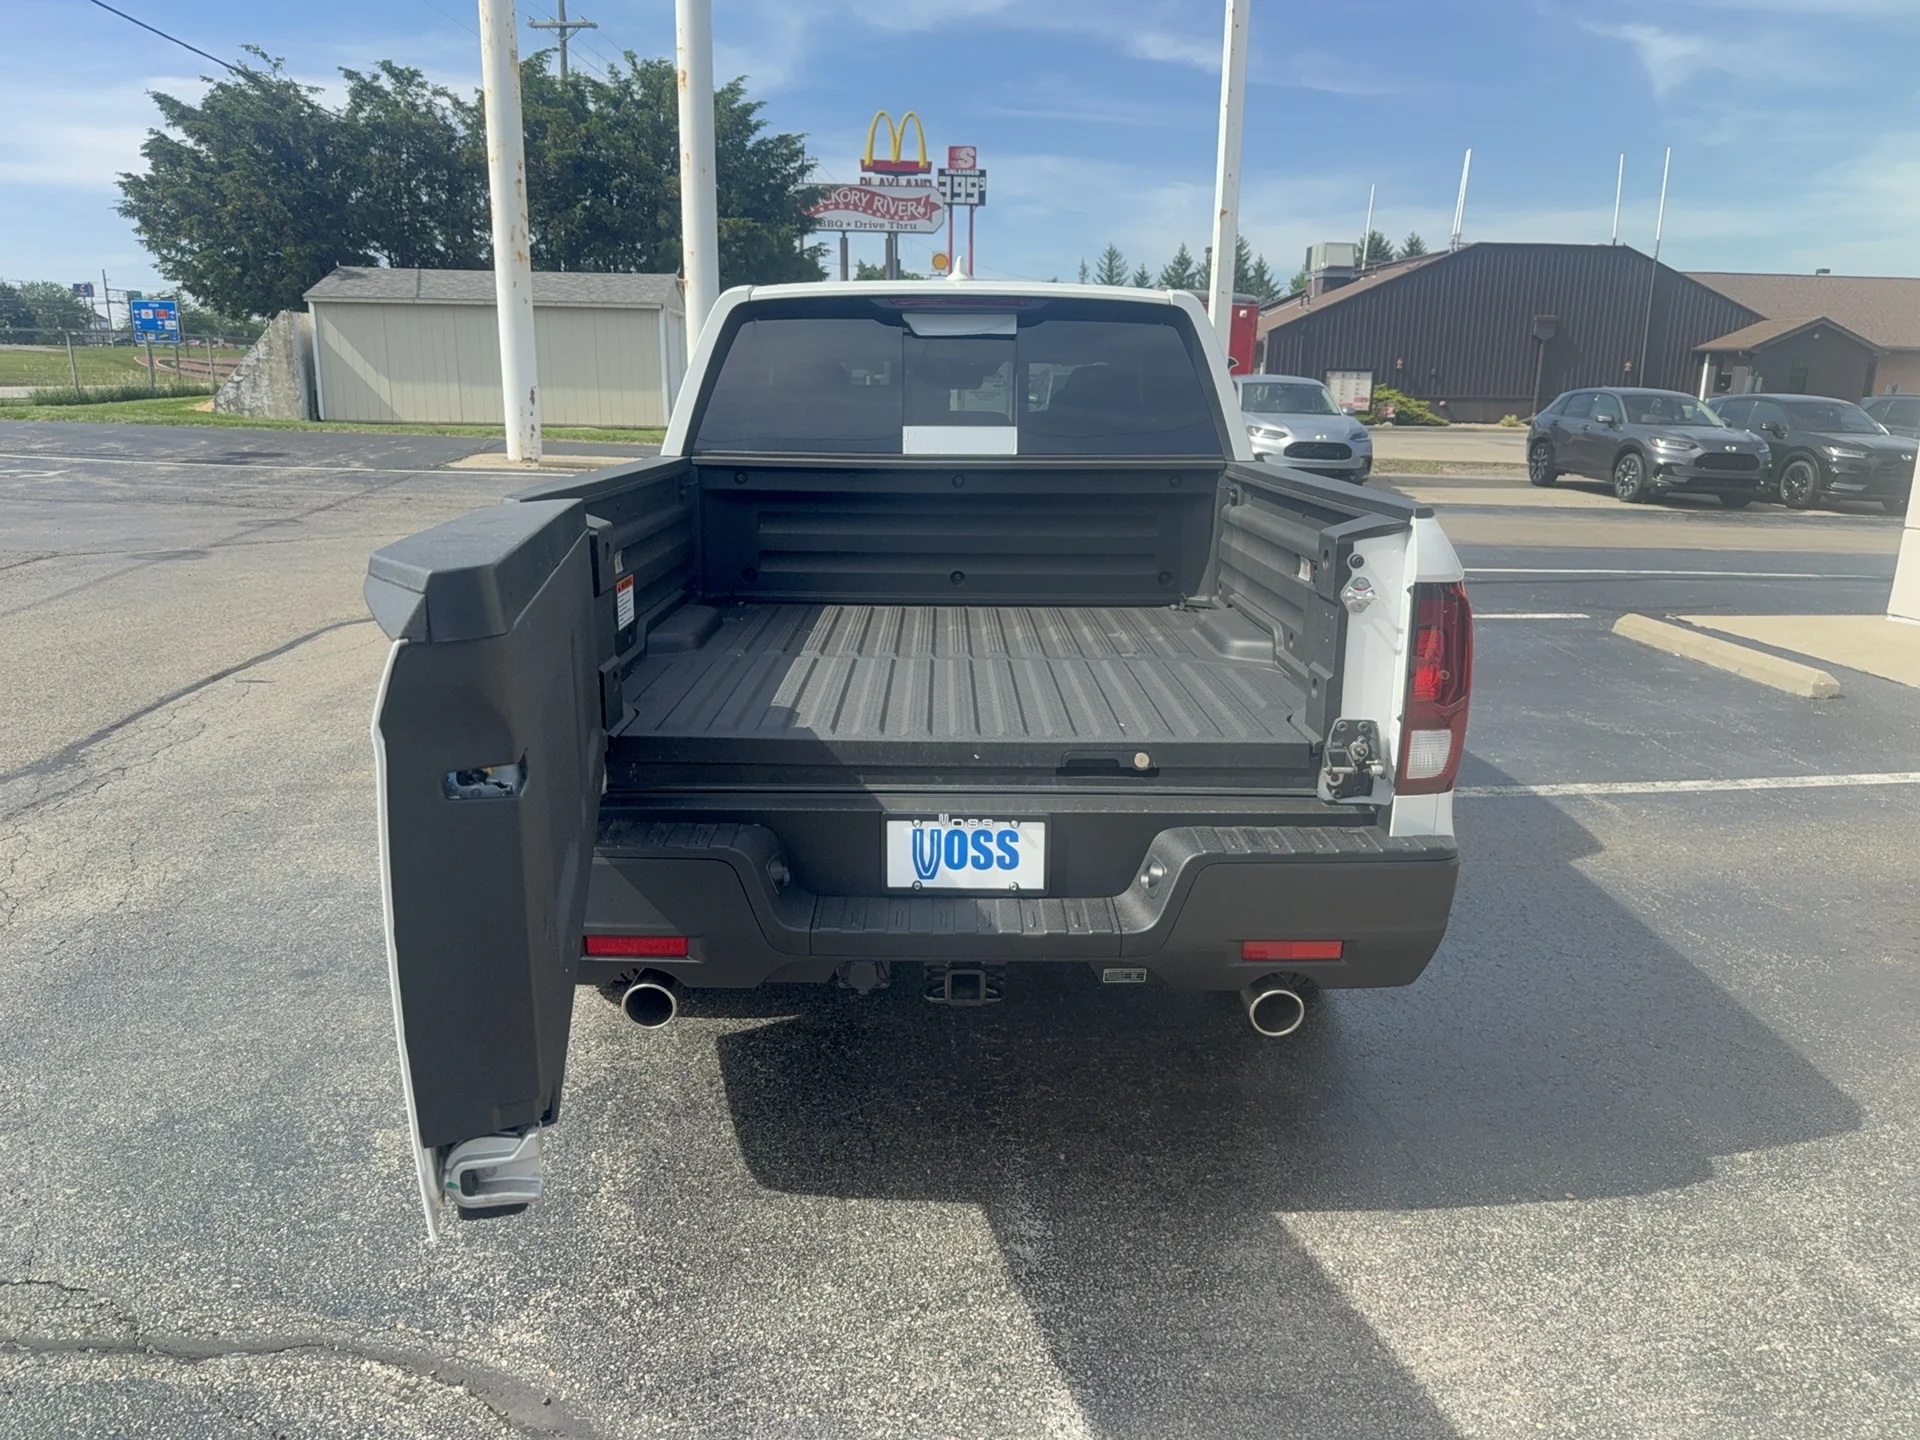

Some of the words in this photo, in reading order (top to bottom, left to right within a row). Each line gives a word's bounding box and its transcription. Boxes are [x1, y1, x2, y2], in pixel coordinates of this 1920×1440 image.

[820, 220, 843, 228] BBQ
[854, 221, 886, 229] Drive
[888, 221, 917, 230] Thru
[912, 829, 1020, 880] VOSS
